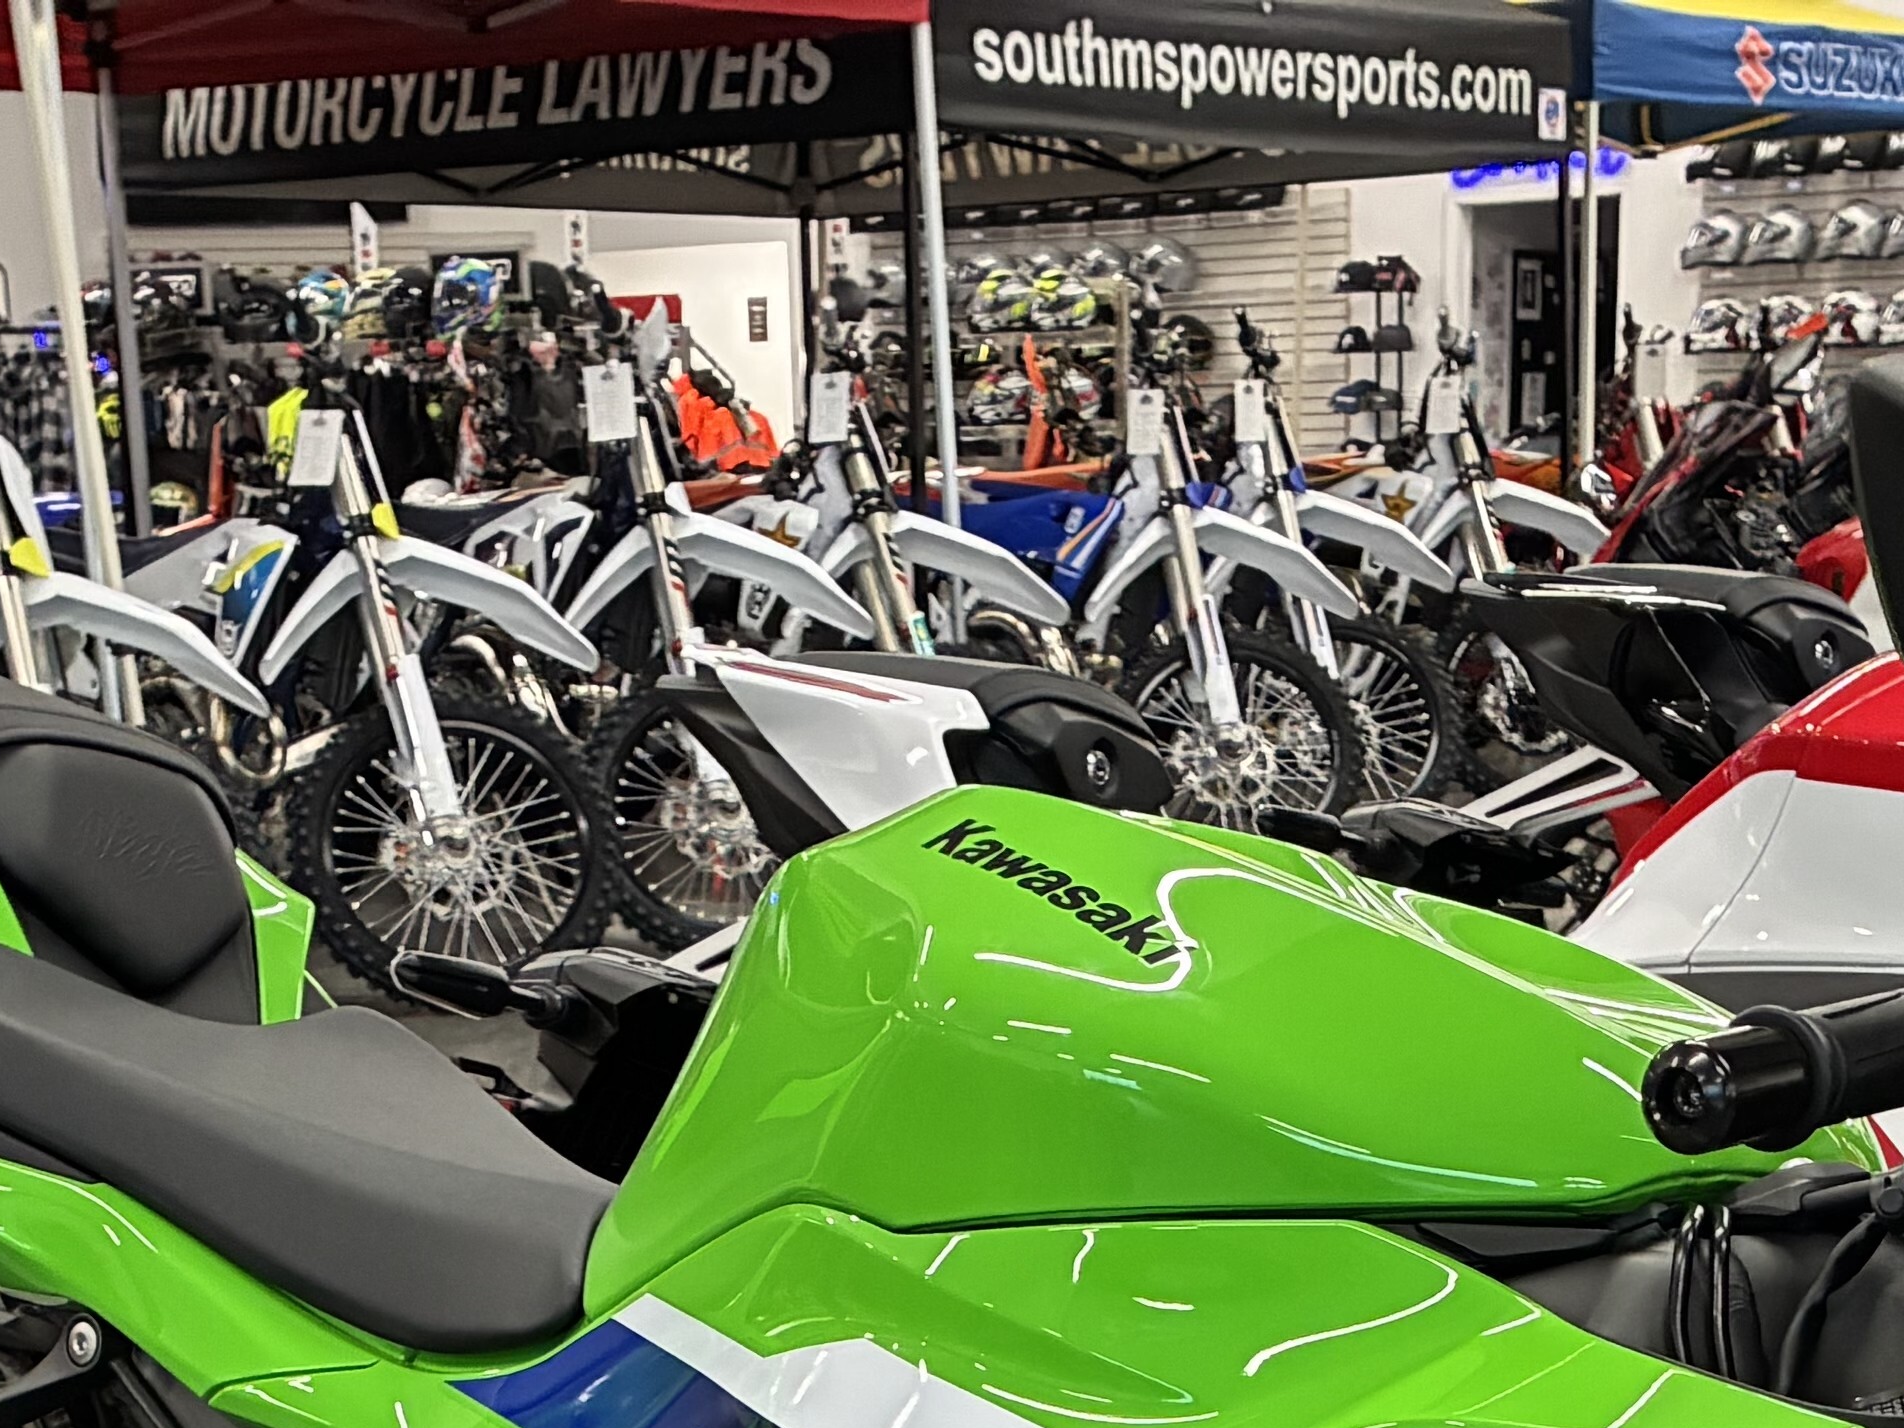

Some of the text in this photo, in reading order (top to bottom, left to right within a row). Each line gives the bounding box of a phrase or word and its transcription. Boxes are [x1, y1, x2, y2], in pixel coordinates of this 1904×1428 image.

[161, 37, 834, 160] MOTORCYCLE LAWYERS
[972, 18, 1533, 119] southmspowersports.com
[921, 818, 1180, 966] Kawasaki
